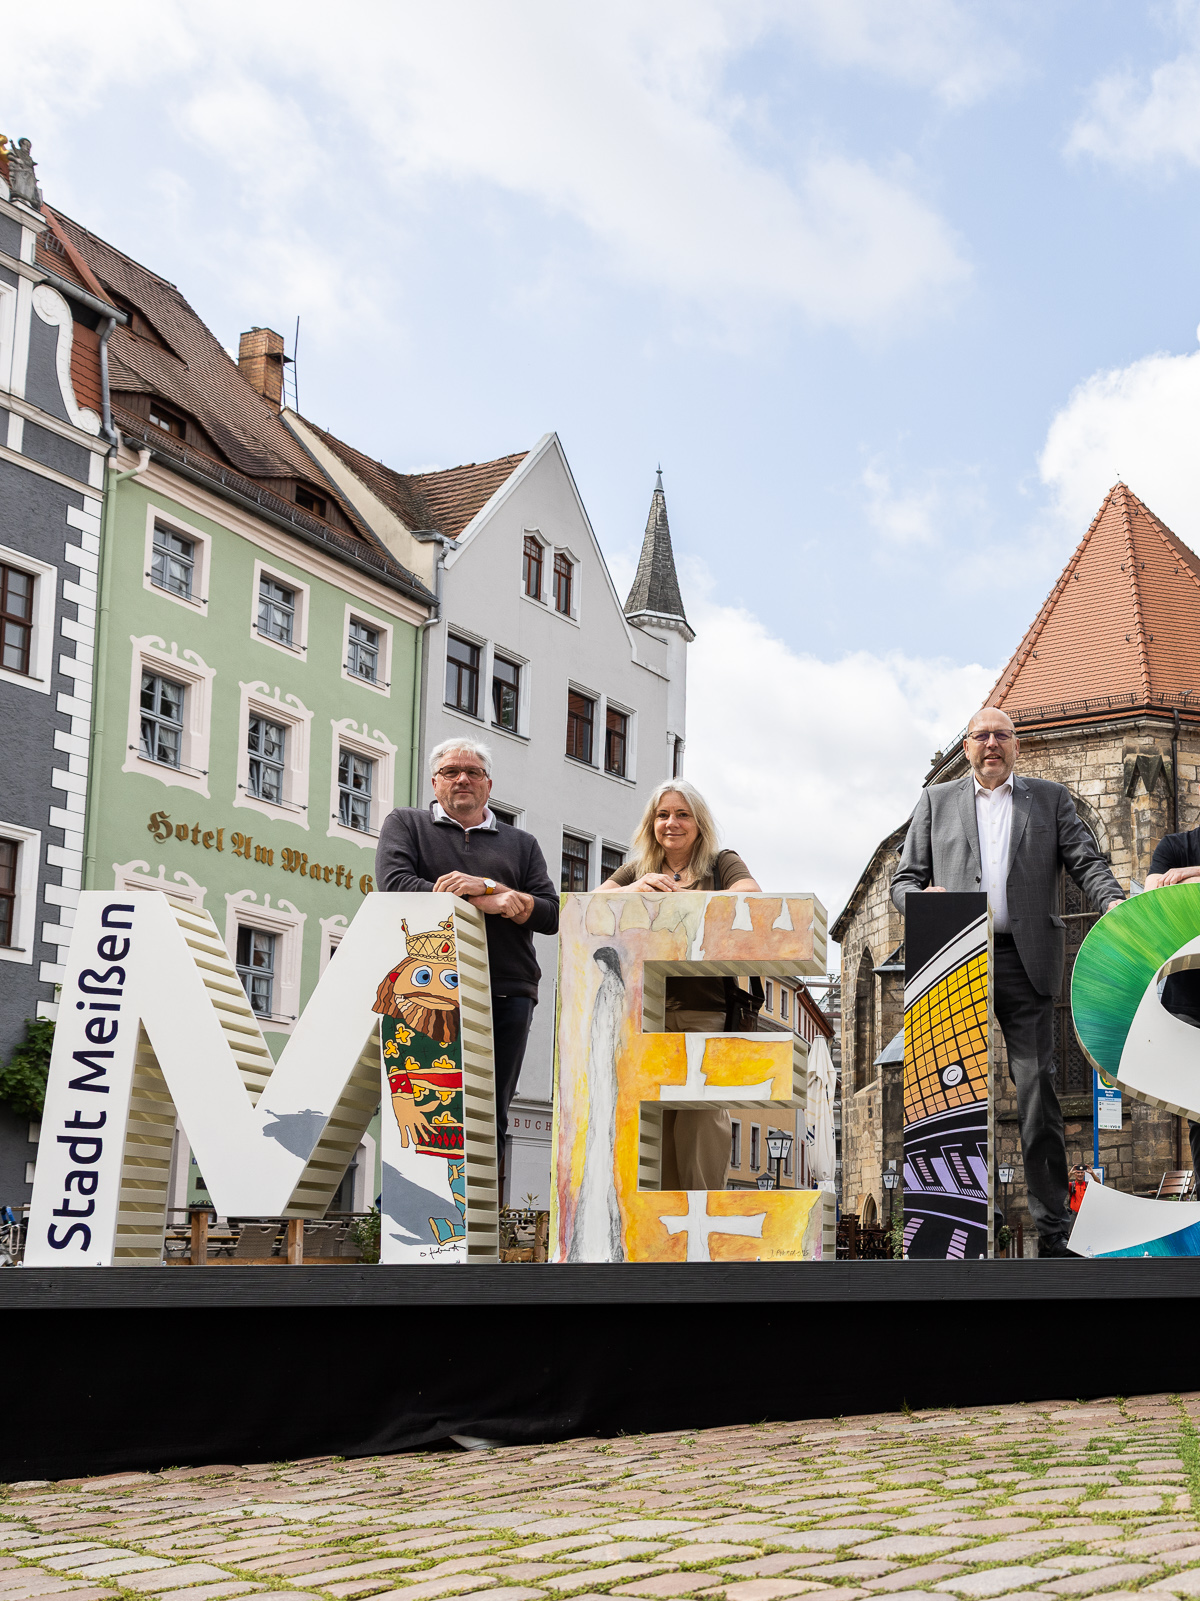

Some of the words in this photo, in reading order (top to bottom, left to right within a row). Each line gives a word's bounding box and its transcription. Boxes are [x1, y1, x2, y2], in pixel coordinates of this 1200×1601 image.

[147, 811, 225, 852] Hotel
[231, 832, 274, 866] Am
[280, 847, 353, 890] Markt
[359, 874, 373, 895] 6
[68, 903, 135, 1094] Meißen
[507, 1117, 552, 1131] BUCH
[47, 1110, 107, 1252] Stadt
